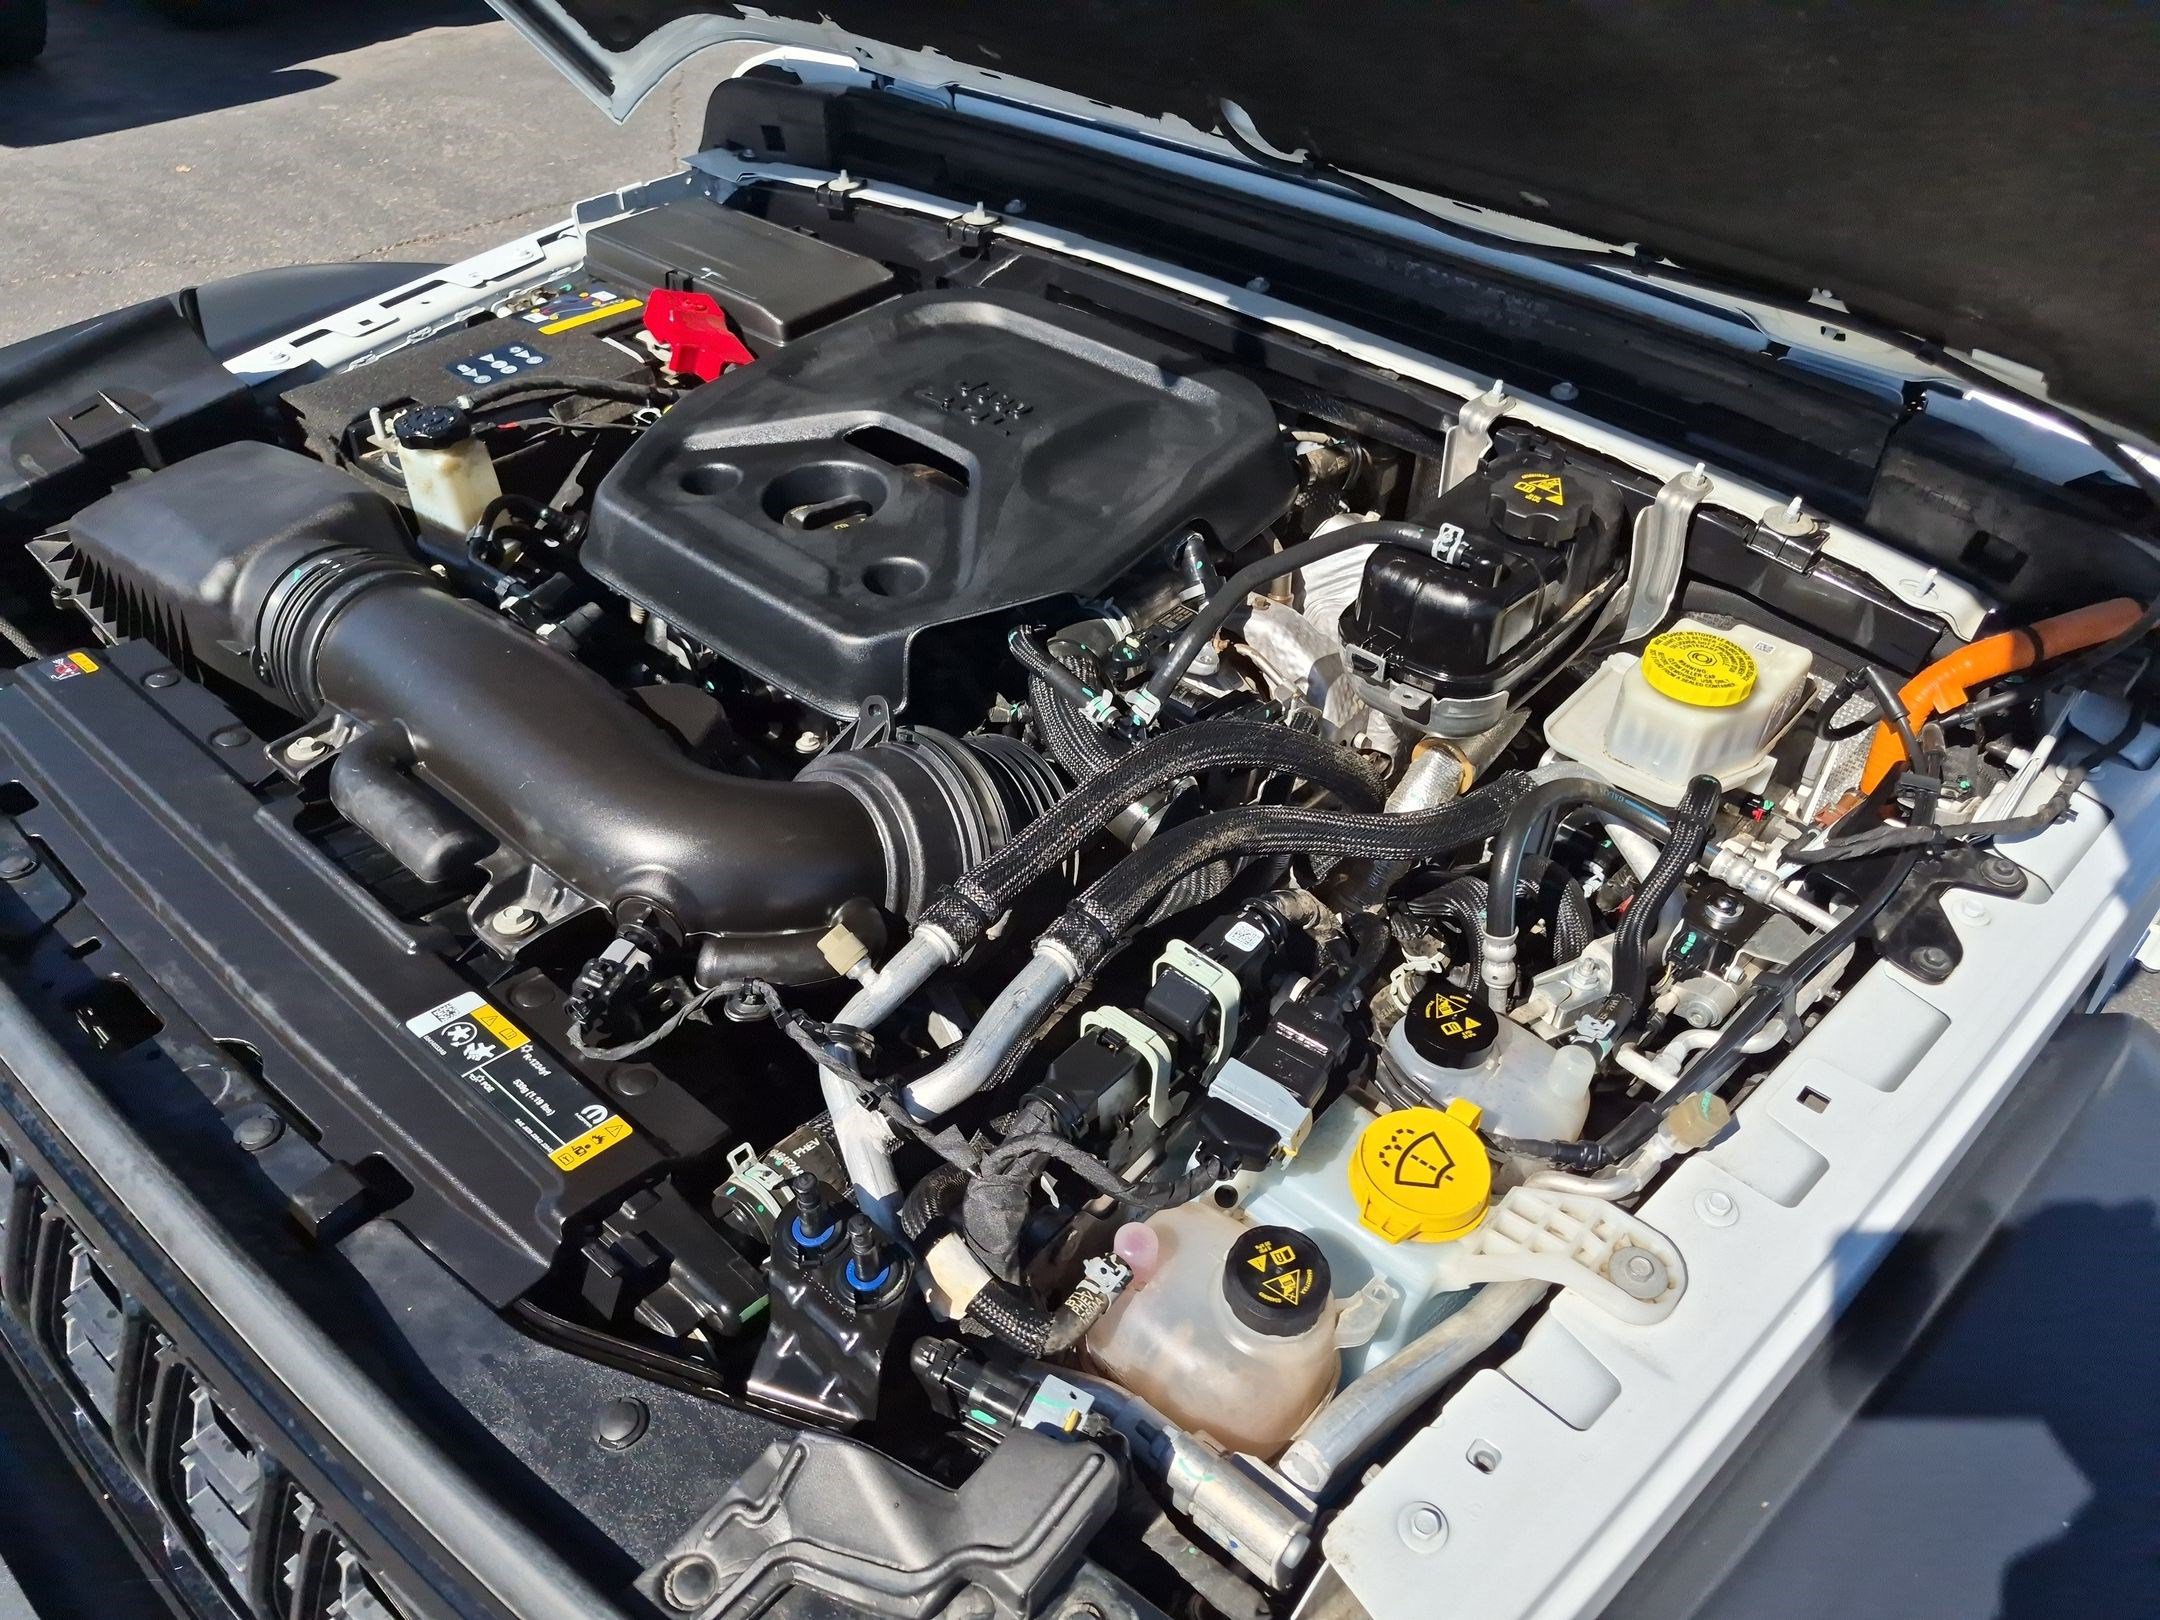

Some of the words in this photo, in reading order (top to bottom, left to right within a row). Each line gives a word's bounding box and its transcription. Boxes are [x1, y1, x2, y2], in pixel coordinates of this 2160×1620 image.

[523, 1053, 552, 1077] R-1234yf
[480, 1081, 495, 1093] POE
[513, 1079, 529, 1094] 539g
[525, 1090, 544, 1106] (1.19
[540, 1102, 556, 1116] lbs)
[792, 1137, 821, 1158] PHEV
[1064, 1291, 1086, 1307] BTL
[1071, 1290, 1094, 1316] PHEV
